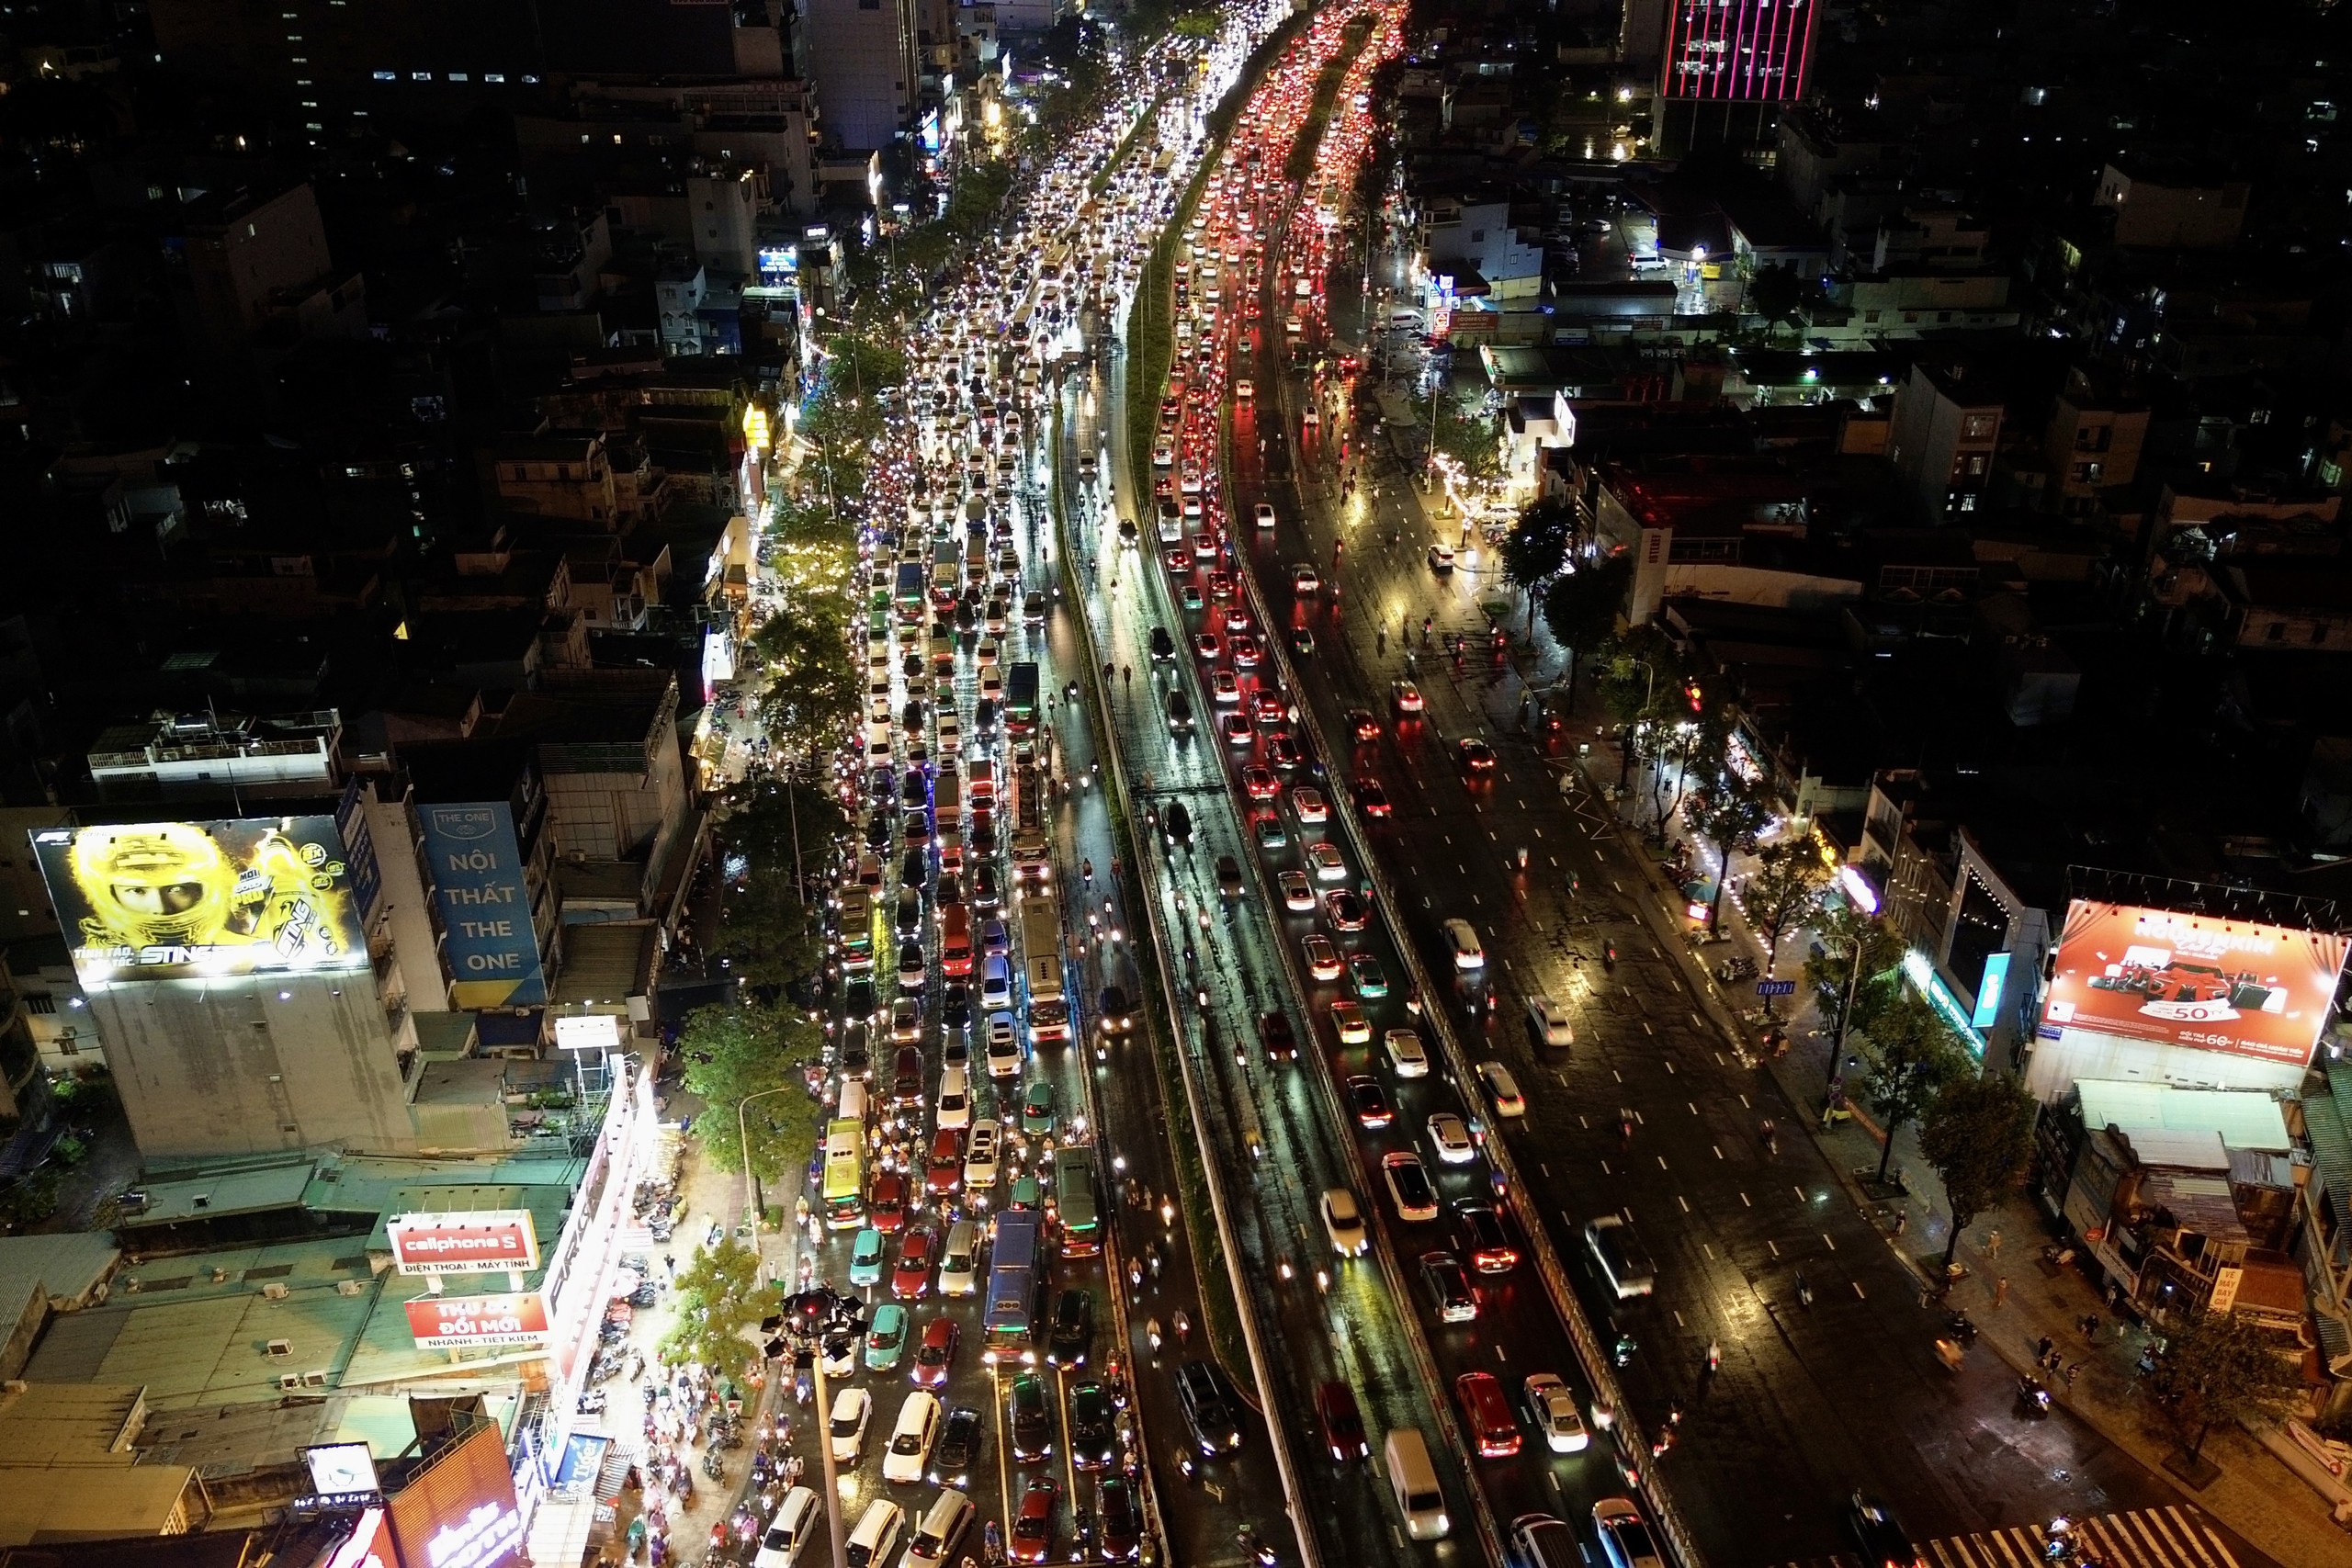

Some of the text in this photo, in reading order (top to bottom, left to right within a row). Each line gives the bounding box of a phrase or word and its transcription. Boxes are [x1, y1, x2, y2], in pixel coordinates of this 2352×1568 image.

[438, 813, 490, 822] THE ONE
[449, 849, 497, 874] NỘI
[444, 881, 515, 905] THẤT
[460, 921, 513, 938] THE
[467, 953, 521, 971] ONE
[2173, 1008, 2209, 1020] 50
[405, 1262, 431, 1273] ĐIỆN
[435, 1263, 467, 1272] THOẠI
[478, 1261, 501, 1269] MÁY
[506, 1259, 530, 1269] TÍNH
[428, 1338, 471, 1347] NHANH
